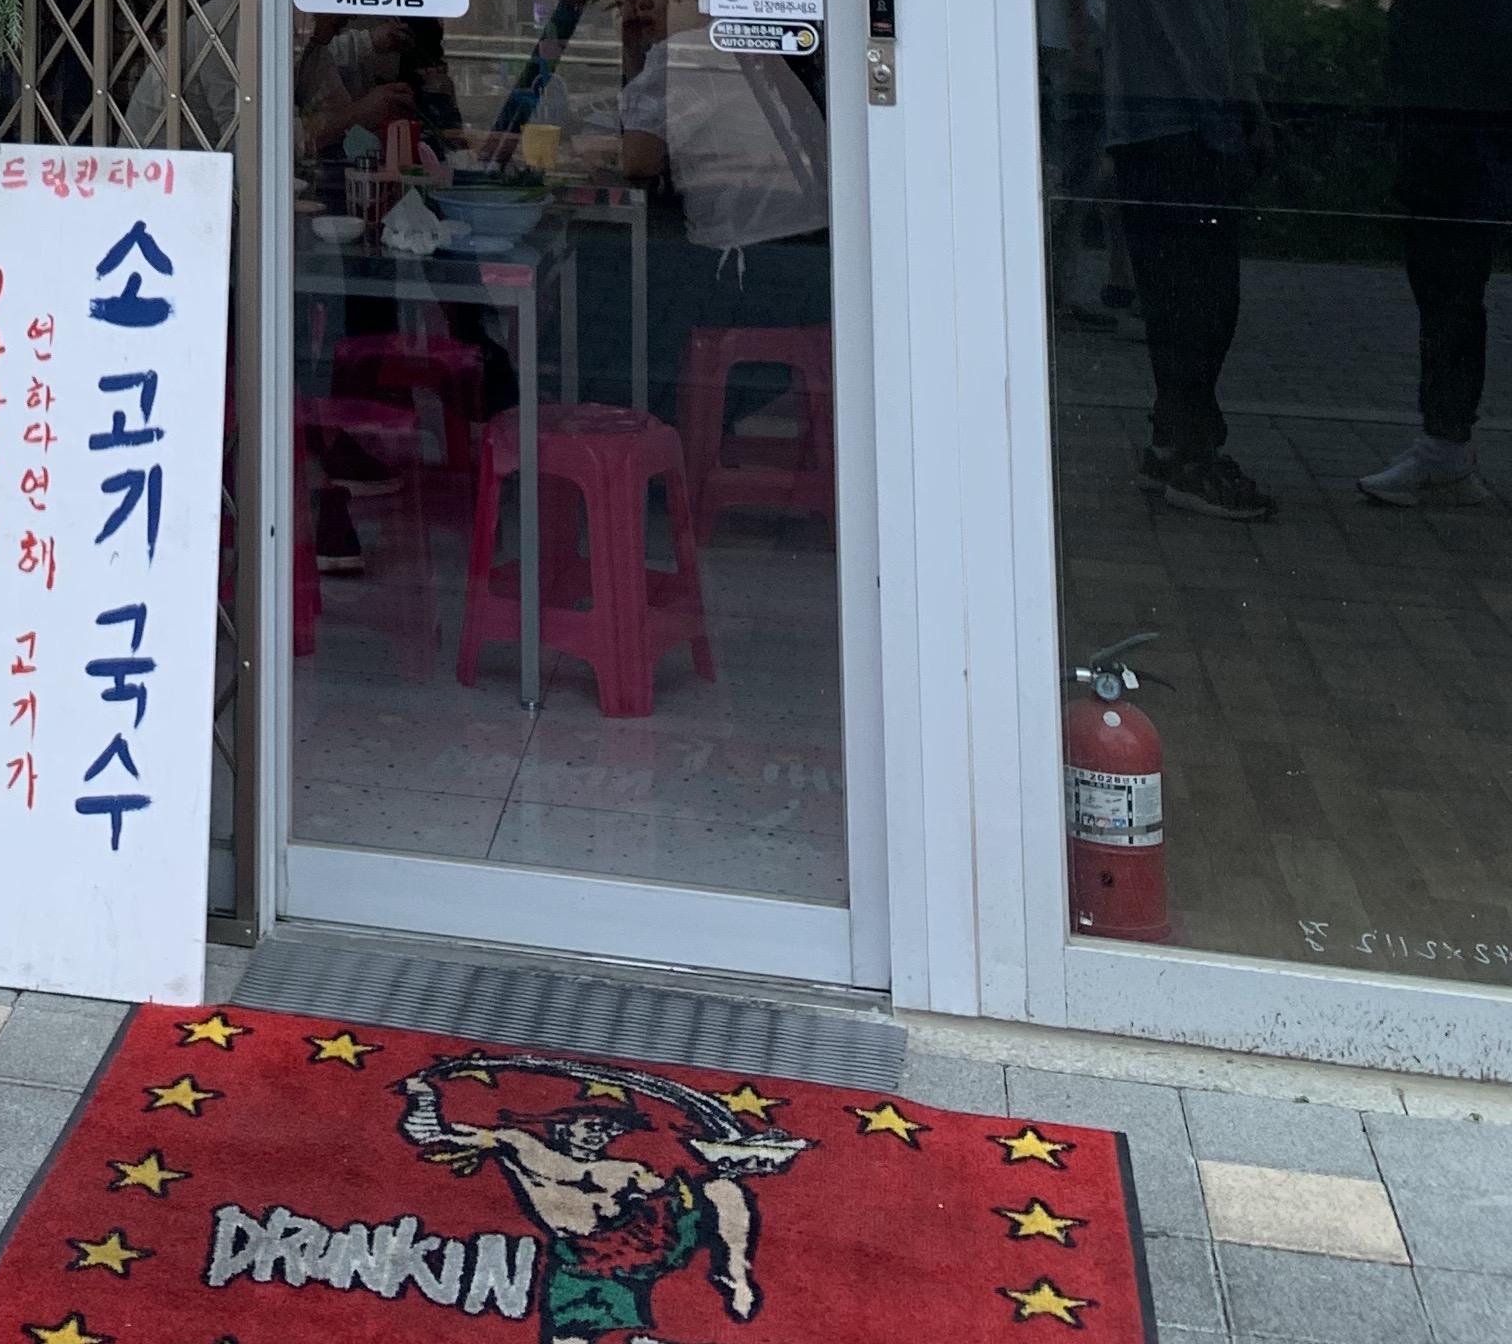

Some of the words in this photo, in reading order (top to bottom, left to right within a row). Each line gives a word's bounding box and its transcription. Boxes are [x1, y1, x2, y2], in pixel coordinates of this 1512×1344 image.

[720, 38, 746, 47] AUTO
[747, 38, 778, 49] DOOR
[206, 1204, 537, 1319] DRUNKIN
